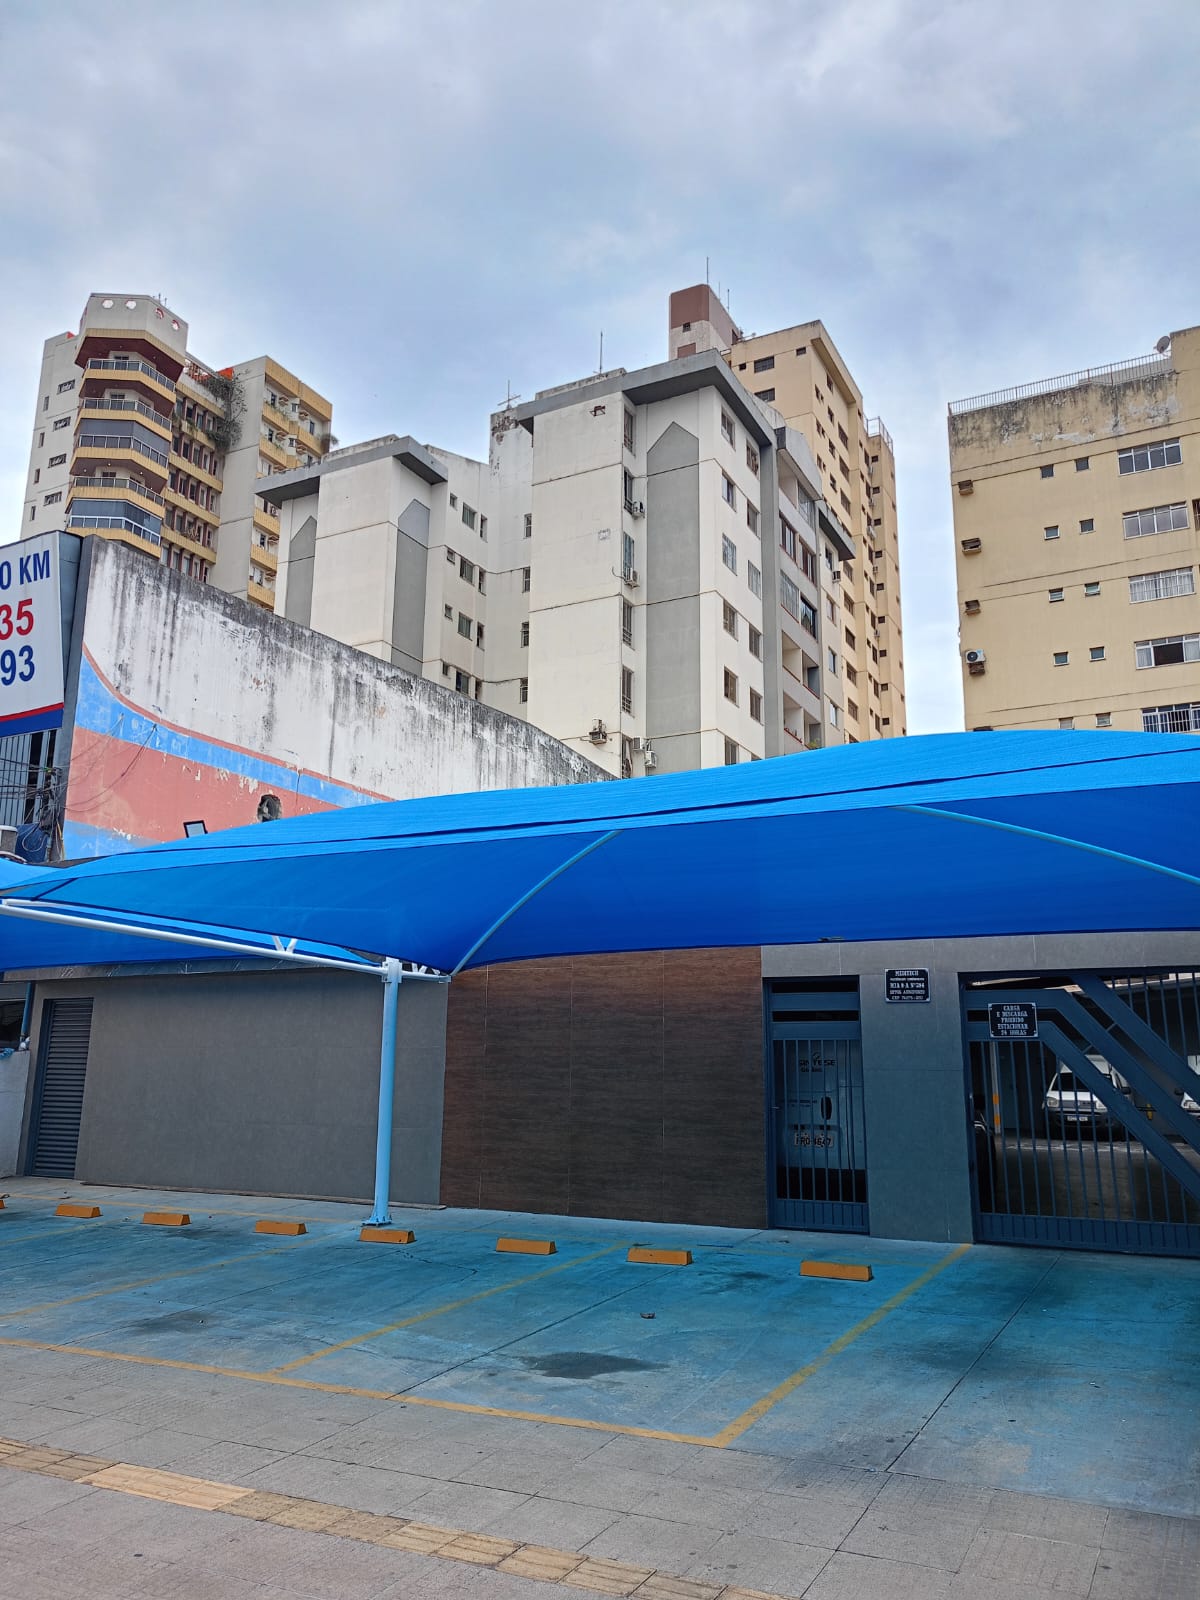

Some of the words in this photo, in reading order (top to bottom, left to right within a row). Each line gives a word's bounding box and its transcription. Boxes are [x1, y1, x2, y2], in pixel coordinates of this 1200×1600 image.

[19, 549, 51, 586] KM
[0, 598, 35, 641] 35
[0, 645, 36, 686] 93
